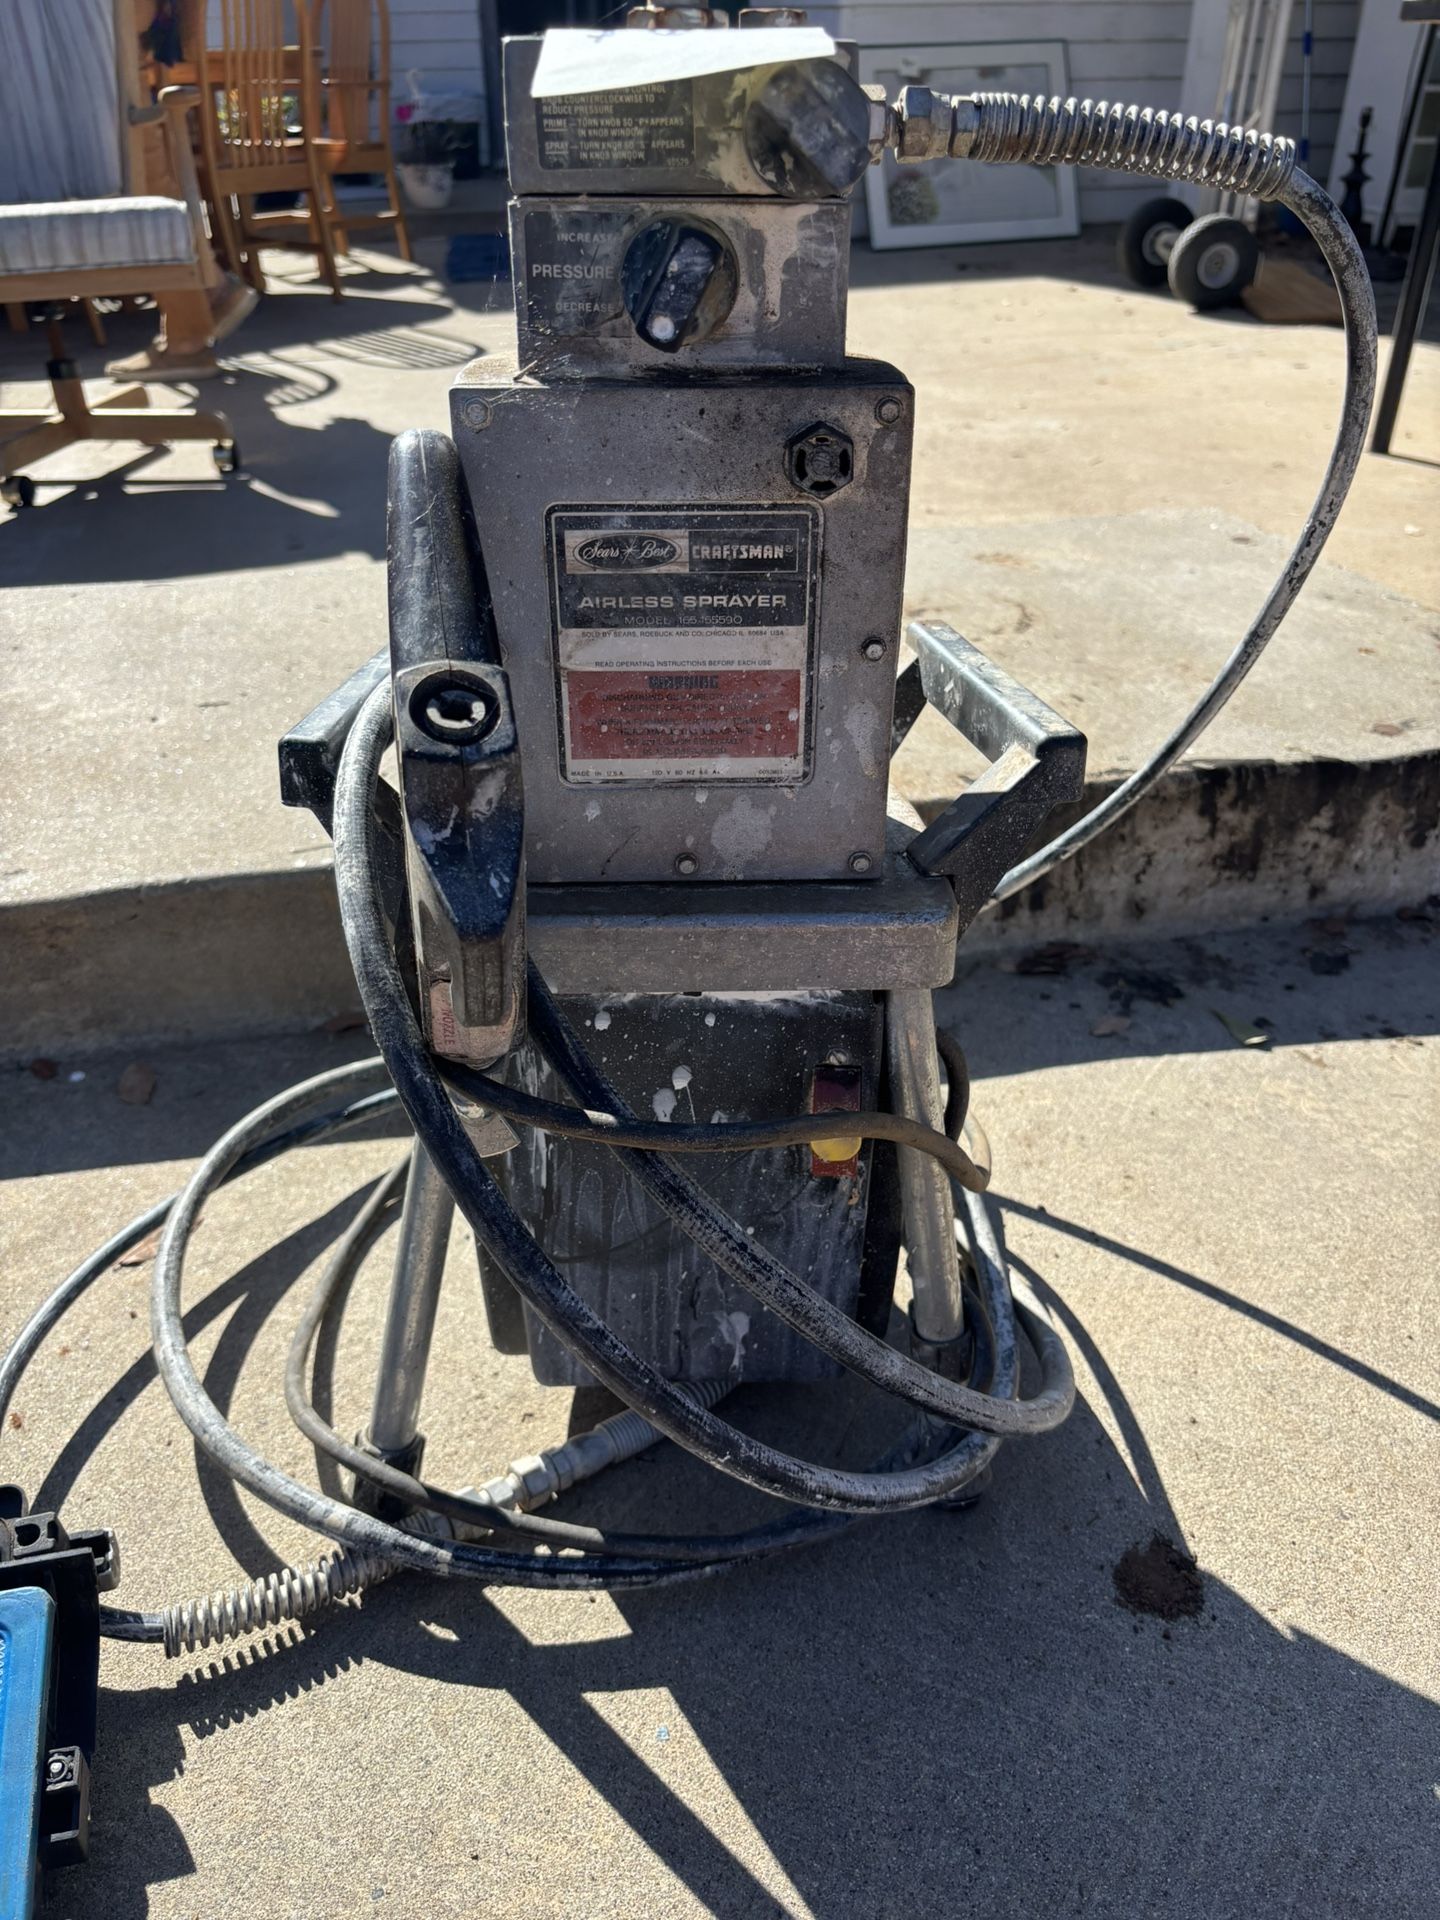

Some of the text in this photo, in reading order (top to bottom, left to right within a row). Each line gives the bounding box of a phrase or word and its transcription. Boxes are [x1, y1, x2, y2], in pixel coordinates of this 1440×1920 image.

[631, 84, 666, 94] CONTROL
[564, 94, 644, 104] COUNTERCLOCKWISE
[645, 94, 655, 103] TO
[542, 104, 614, 115] REDUCE PRESSURE
[543, 118, 568, 128] PRIME
[577, 118, 598, 127] TURN
[600, 117, 621, 127] KNOB
[623, 117, 633, 127] SO
[650, 117, 685, 126] APPEARS
[578, 127, 644, 137] IN KNOB WINDOW
[545, 141, 569, 151] SPRAY
[580, 140, 600, 150] TURN
[602, 140, 623, 150] KNOB
[651, 139, 686, 149] APPEARS
[580, 151, 646, 161] IN KNOB WINDOW
[557, 233, 616, 243] INCREASE
[532, 263, 615, 280] PRESSURE
[555, 302, 615, 313] DECREASE
[582, 540, 620, 560] Sears
[639, 540, 674, 559] Best
[577, 594, 787, 609] AIRLESS SPRAYER
[624, 615, 671, 625] MODEL
[708, 659, 735, 667] BEFORE
[442, 1007, 456, 1047] NOZZLE
